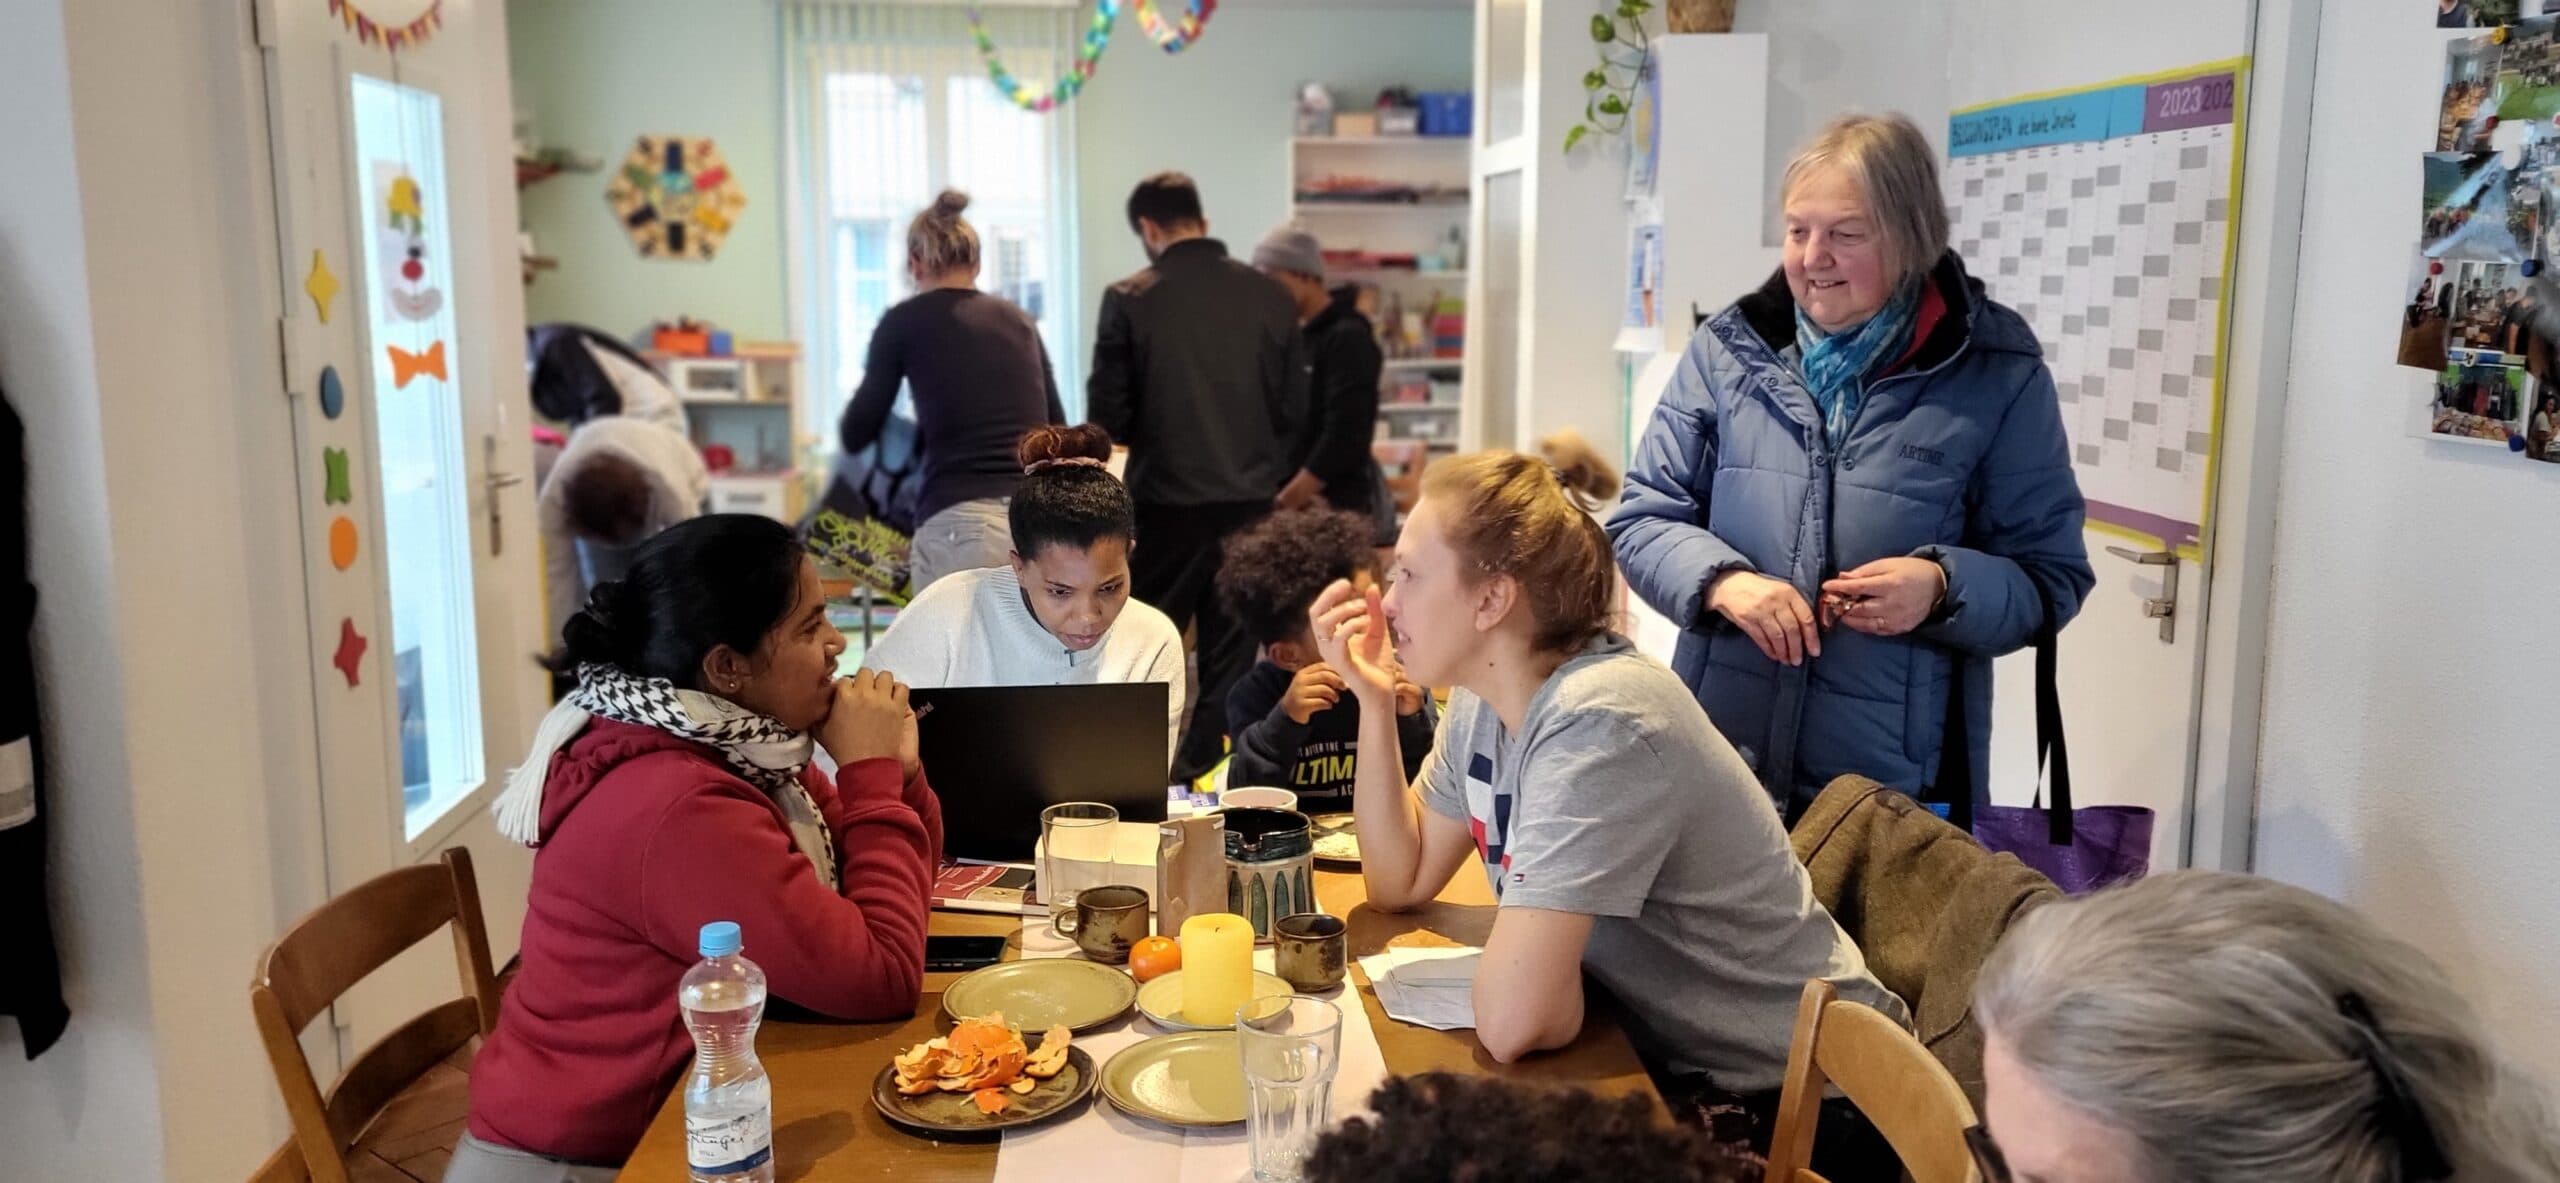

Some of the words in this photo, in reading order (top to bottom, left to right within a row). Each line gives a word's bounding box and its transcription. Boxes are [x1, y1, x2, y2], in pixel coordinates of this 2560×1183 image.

[2160, 85, 2202, 117] 2023
[1326, 741, 1339, 753] THE
[1291, 754, 1355, 784] LTIM
